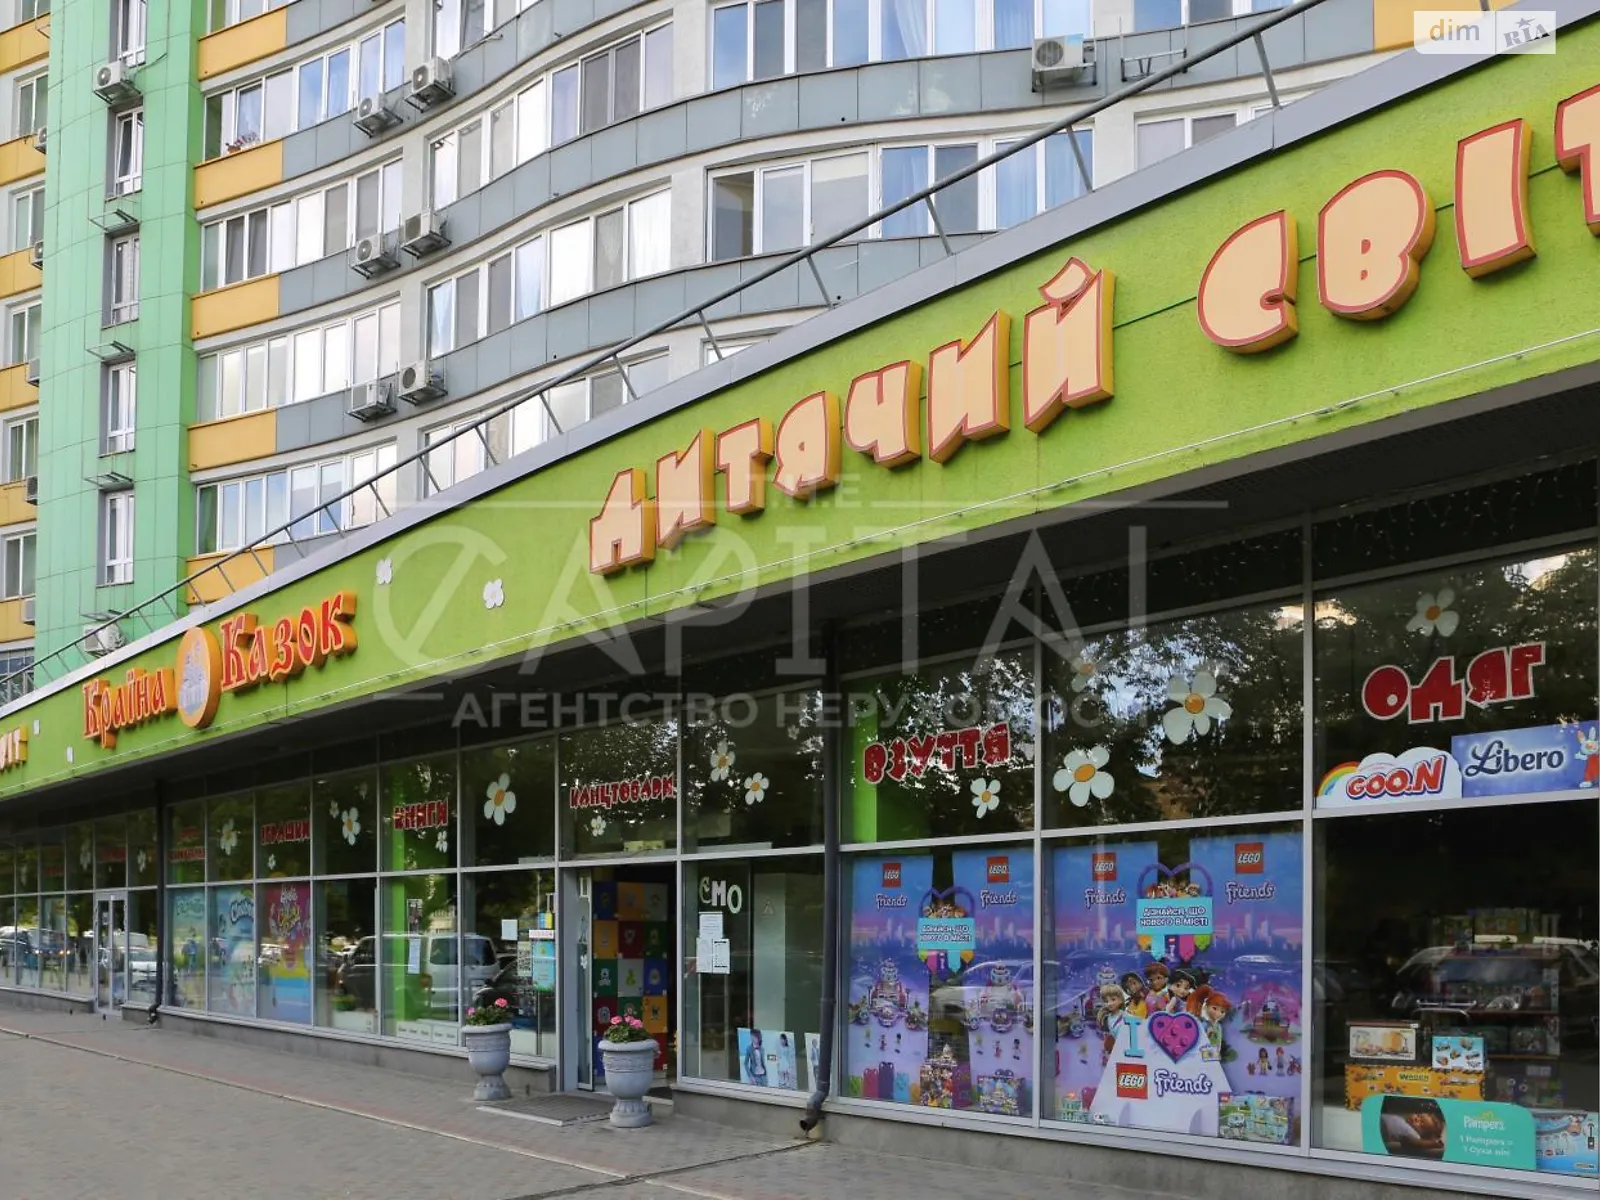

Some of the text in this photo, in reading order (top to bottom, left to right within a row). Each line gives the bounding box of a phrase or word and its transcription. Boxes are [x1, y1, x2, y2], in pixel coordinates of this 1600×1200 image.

[589, 257, 1113, 575] ДИТЯЧИЙ
[82, 591, 358, 750] Країна Казок
[1362, 641, 1546, 724] ОДЯГ
[863, 721, 1011, 784] ВЗУТТЯ
[1465, 740, 1565, 778] Libero
[988, 863, 1009, 875] LEGO
[1093, 861, 1115, 873] LEGO
[1235, 851, 1262, 865] LEGO
[884, 868, 900, 881] LEGO
[876, 893, 908, 911] Friends
[980, 889, 1017, 909] Friends
[1084, 888, 1126, 909] Friends
[1225, 881, 1275, 904] Friends
[1124, 1016, 1145, 1058] I
[1118, 1069, 1213, 1096] LEGO Friends
[1463, 1115, 1505, 1132] Pampers
